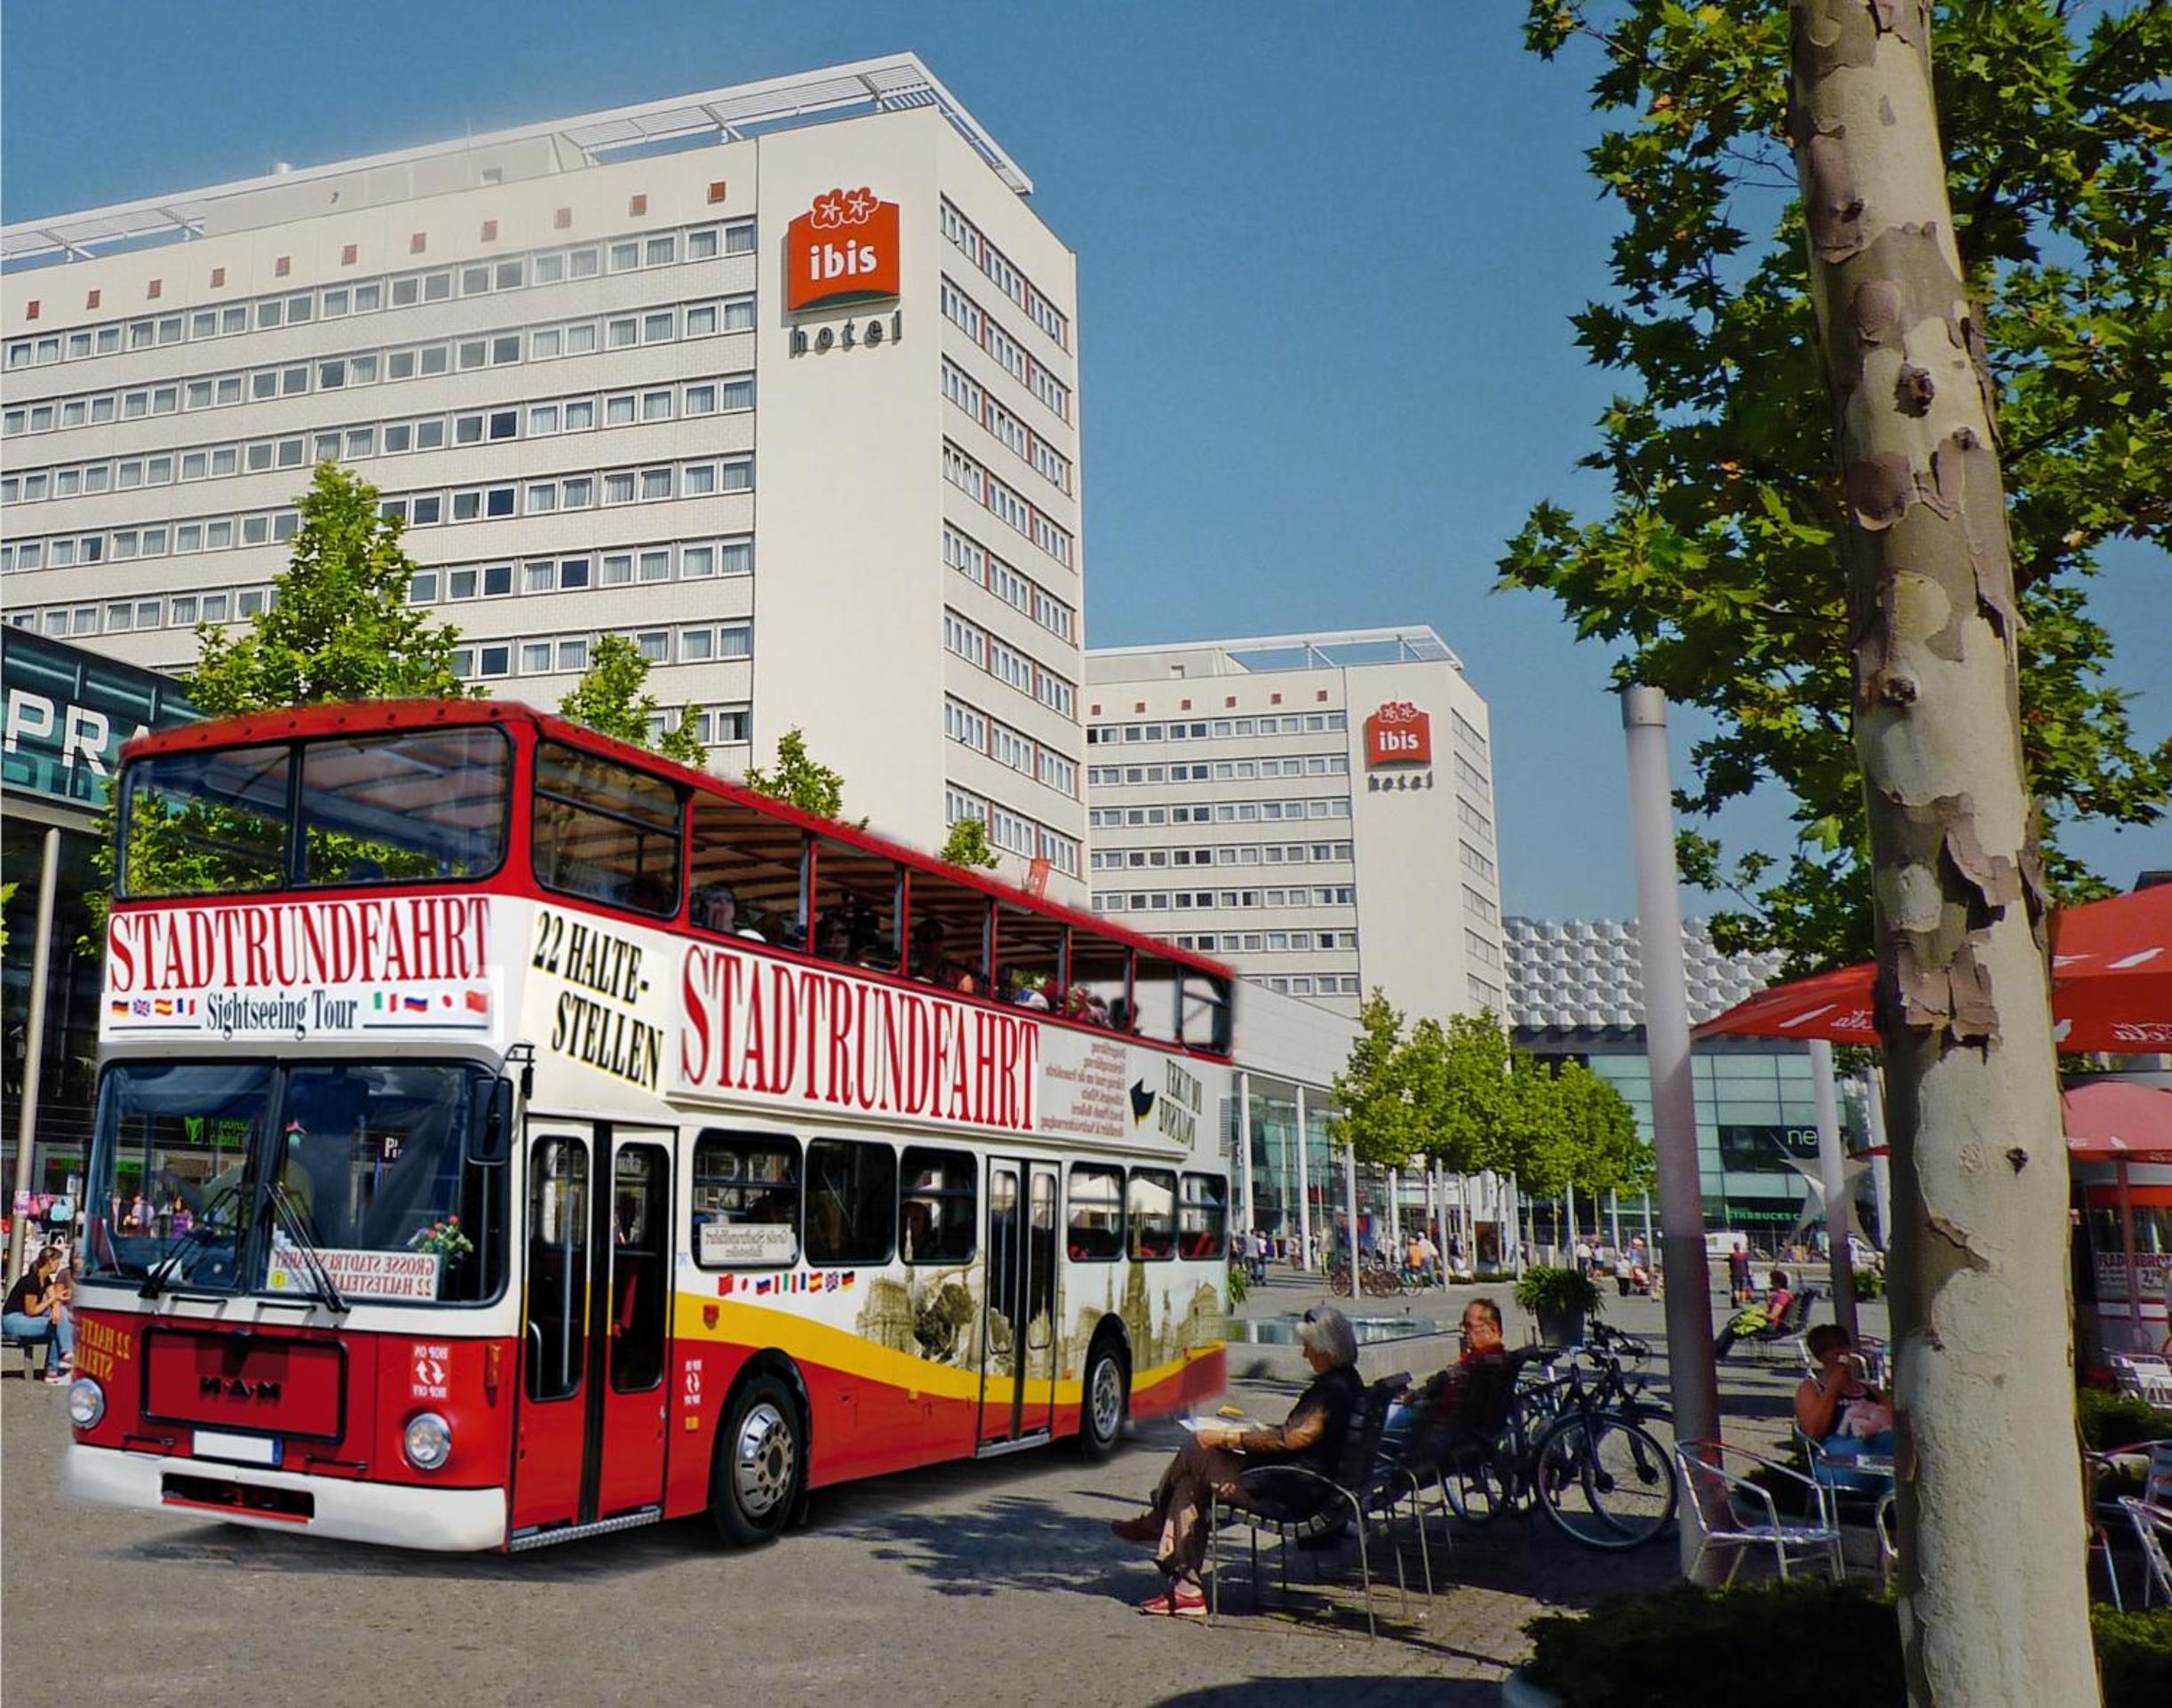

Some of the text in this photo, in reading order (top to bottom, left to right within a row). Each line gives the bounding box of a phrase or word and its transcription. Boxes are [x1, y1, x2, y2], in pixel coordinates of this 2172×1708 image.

[809, 240, 879, 281] ibis
[790, 309, 903, 358] hotel
[1380, 730, 1419, 751] ibis
[1368, 771, 1433, 792] hotel
[109, 897, 489, 992] STADTRUNDFAHRT
[532, 910, 649, 1005] 22 HALTE-
[207, 989, 358, 1041] Sightseeing Tour
[551, 990, 664, 1092] STELLEN
[680, 944, 1039, 1131] STADTRUNDFAHRT
